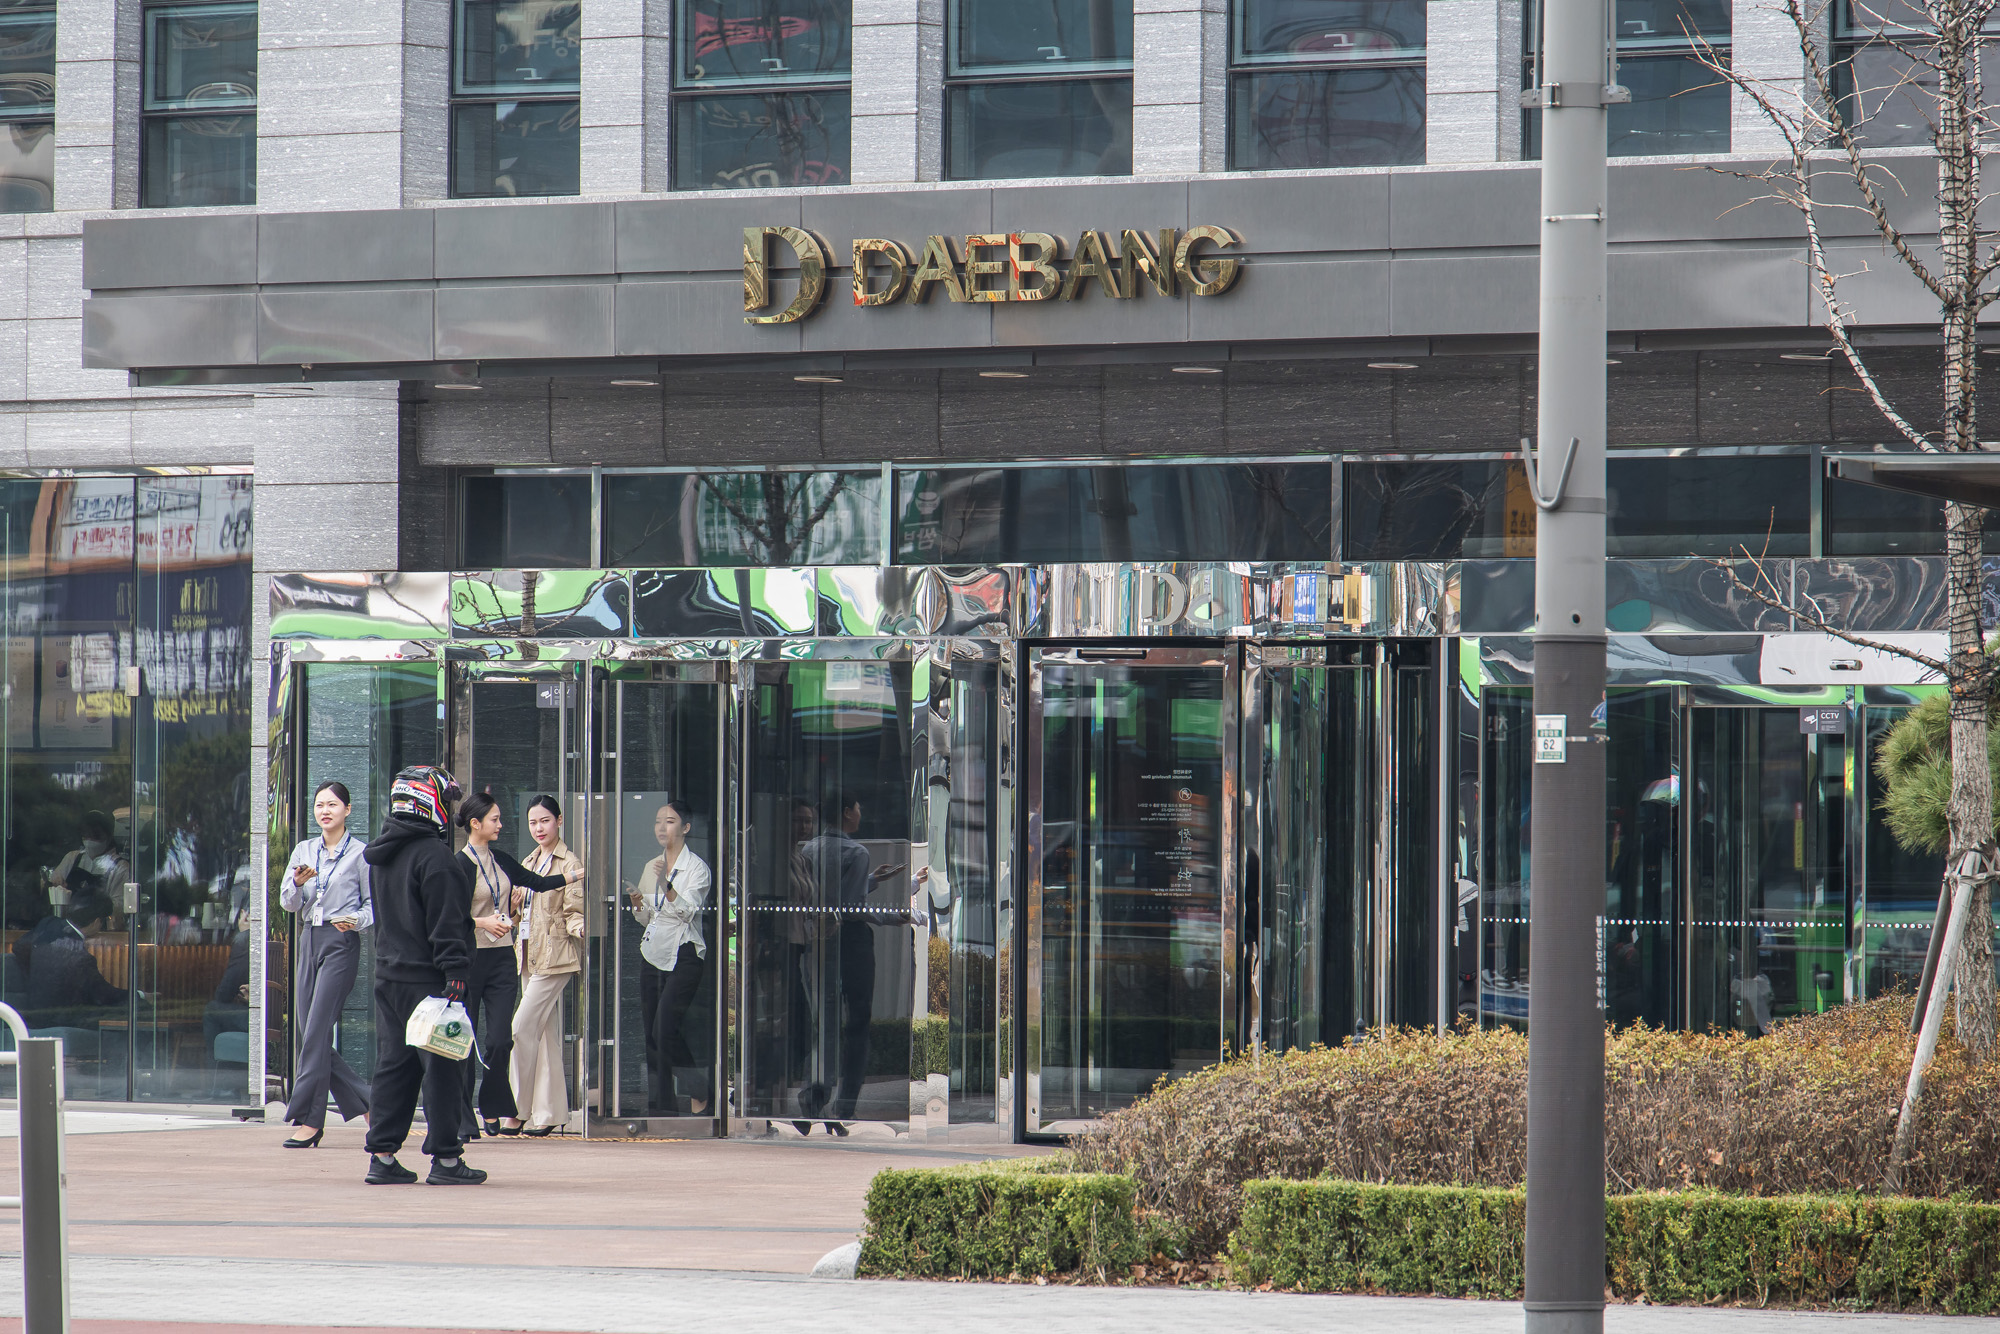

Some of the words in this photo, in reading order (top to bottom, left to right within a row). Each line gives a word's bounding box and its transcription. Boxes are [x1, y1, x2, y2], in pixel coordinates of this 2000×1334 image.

[743, 226, 828, 324] D
[852, 224, 1240, 307] DAEBANG
[1544, 738, 1555, 750] 62
